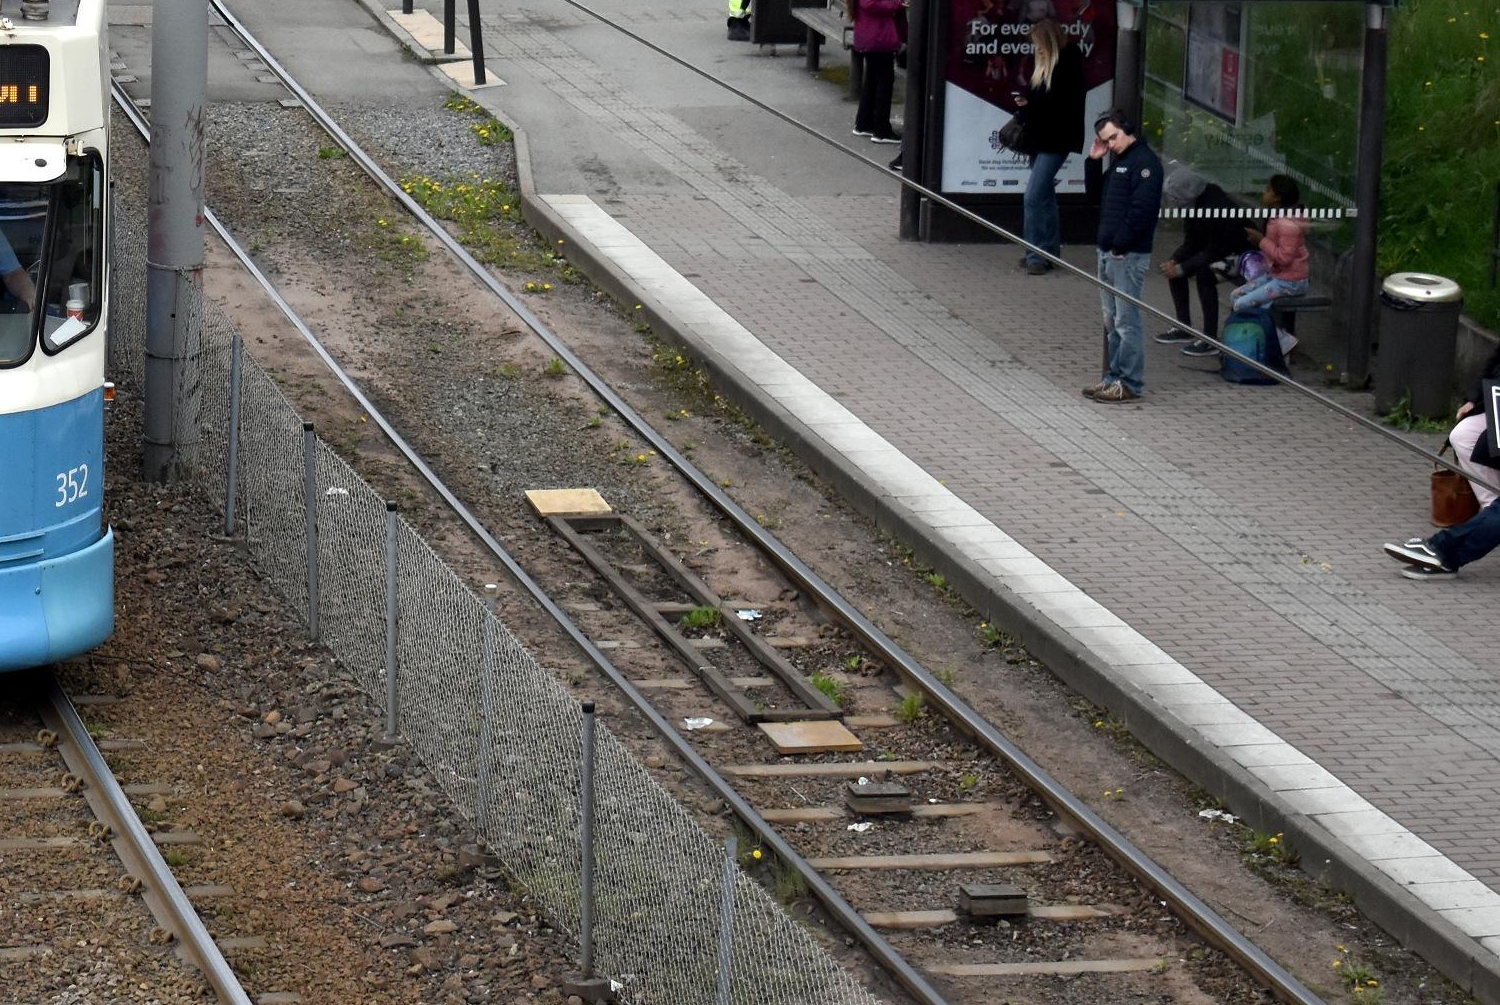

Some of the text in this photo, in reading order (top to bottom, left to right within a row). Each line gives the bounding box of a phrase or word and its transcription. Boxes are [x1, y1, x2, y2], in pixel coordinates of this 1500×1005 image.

[971, 20, 997, 35] For
[965, 39, 998, 54] and
[55, 463, 89, 508] 352
